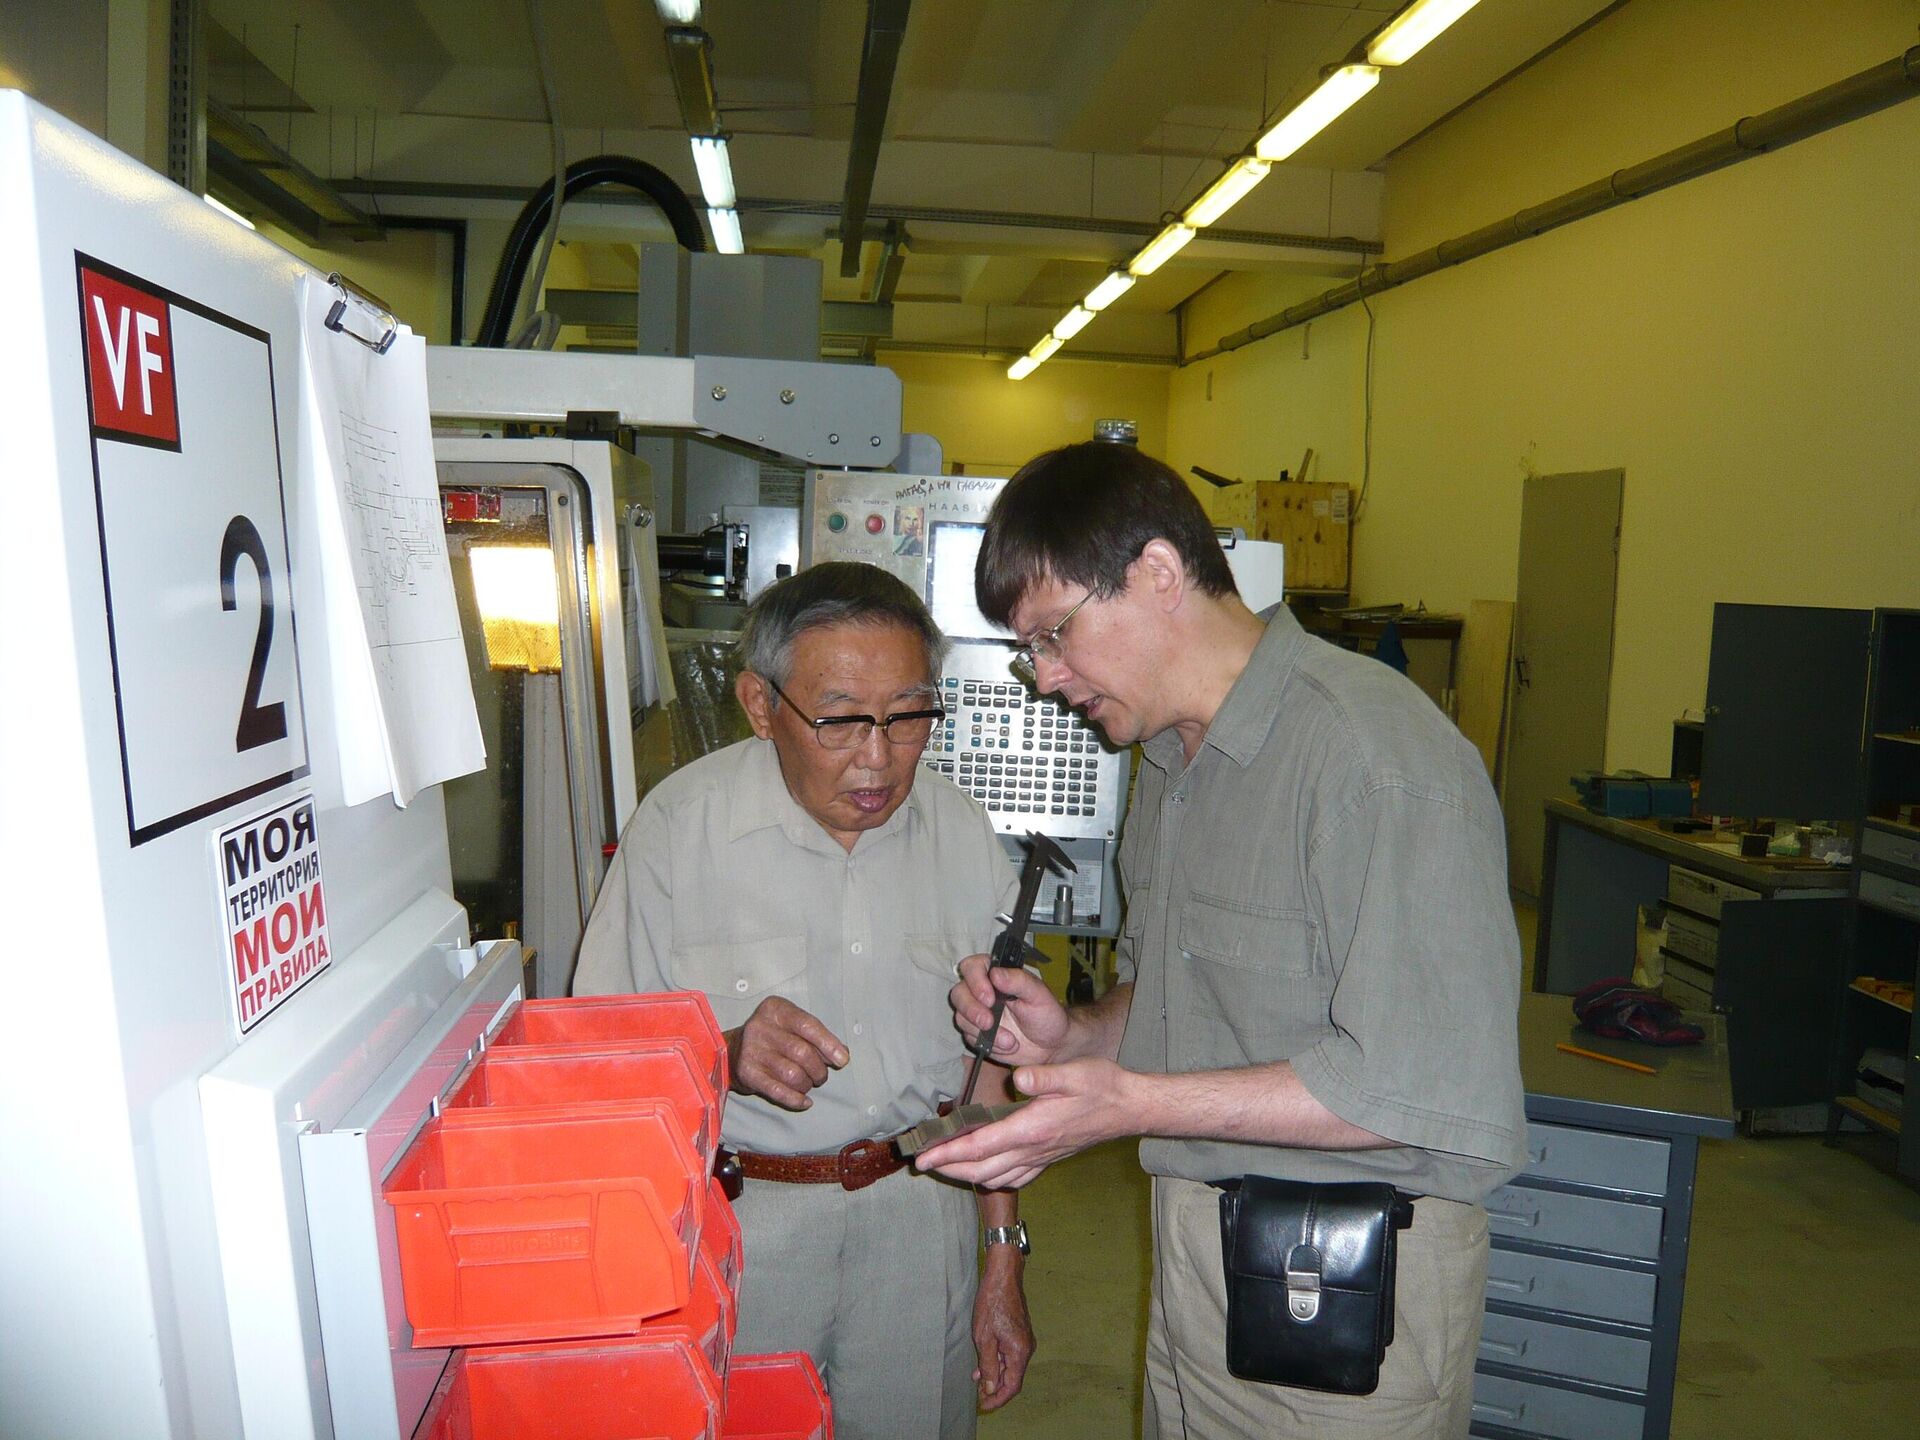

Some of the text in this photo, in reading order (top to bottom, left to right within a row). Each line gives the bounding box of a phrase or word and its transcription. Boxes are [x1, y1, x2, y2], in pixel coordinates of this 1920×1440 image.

[92, 294, 163, 416] VF
[929, 503, 970, 512] HAAS
[219, 515, 288, 753] 2
[223, 803, 316, 888] МОЯ
[230, 851, 320, 926] ТЕРРИТОРИЯ
[233, 882, 325, 985] МОИ
[240, 935, 328, 1022] ПРАВИЛА
